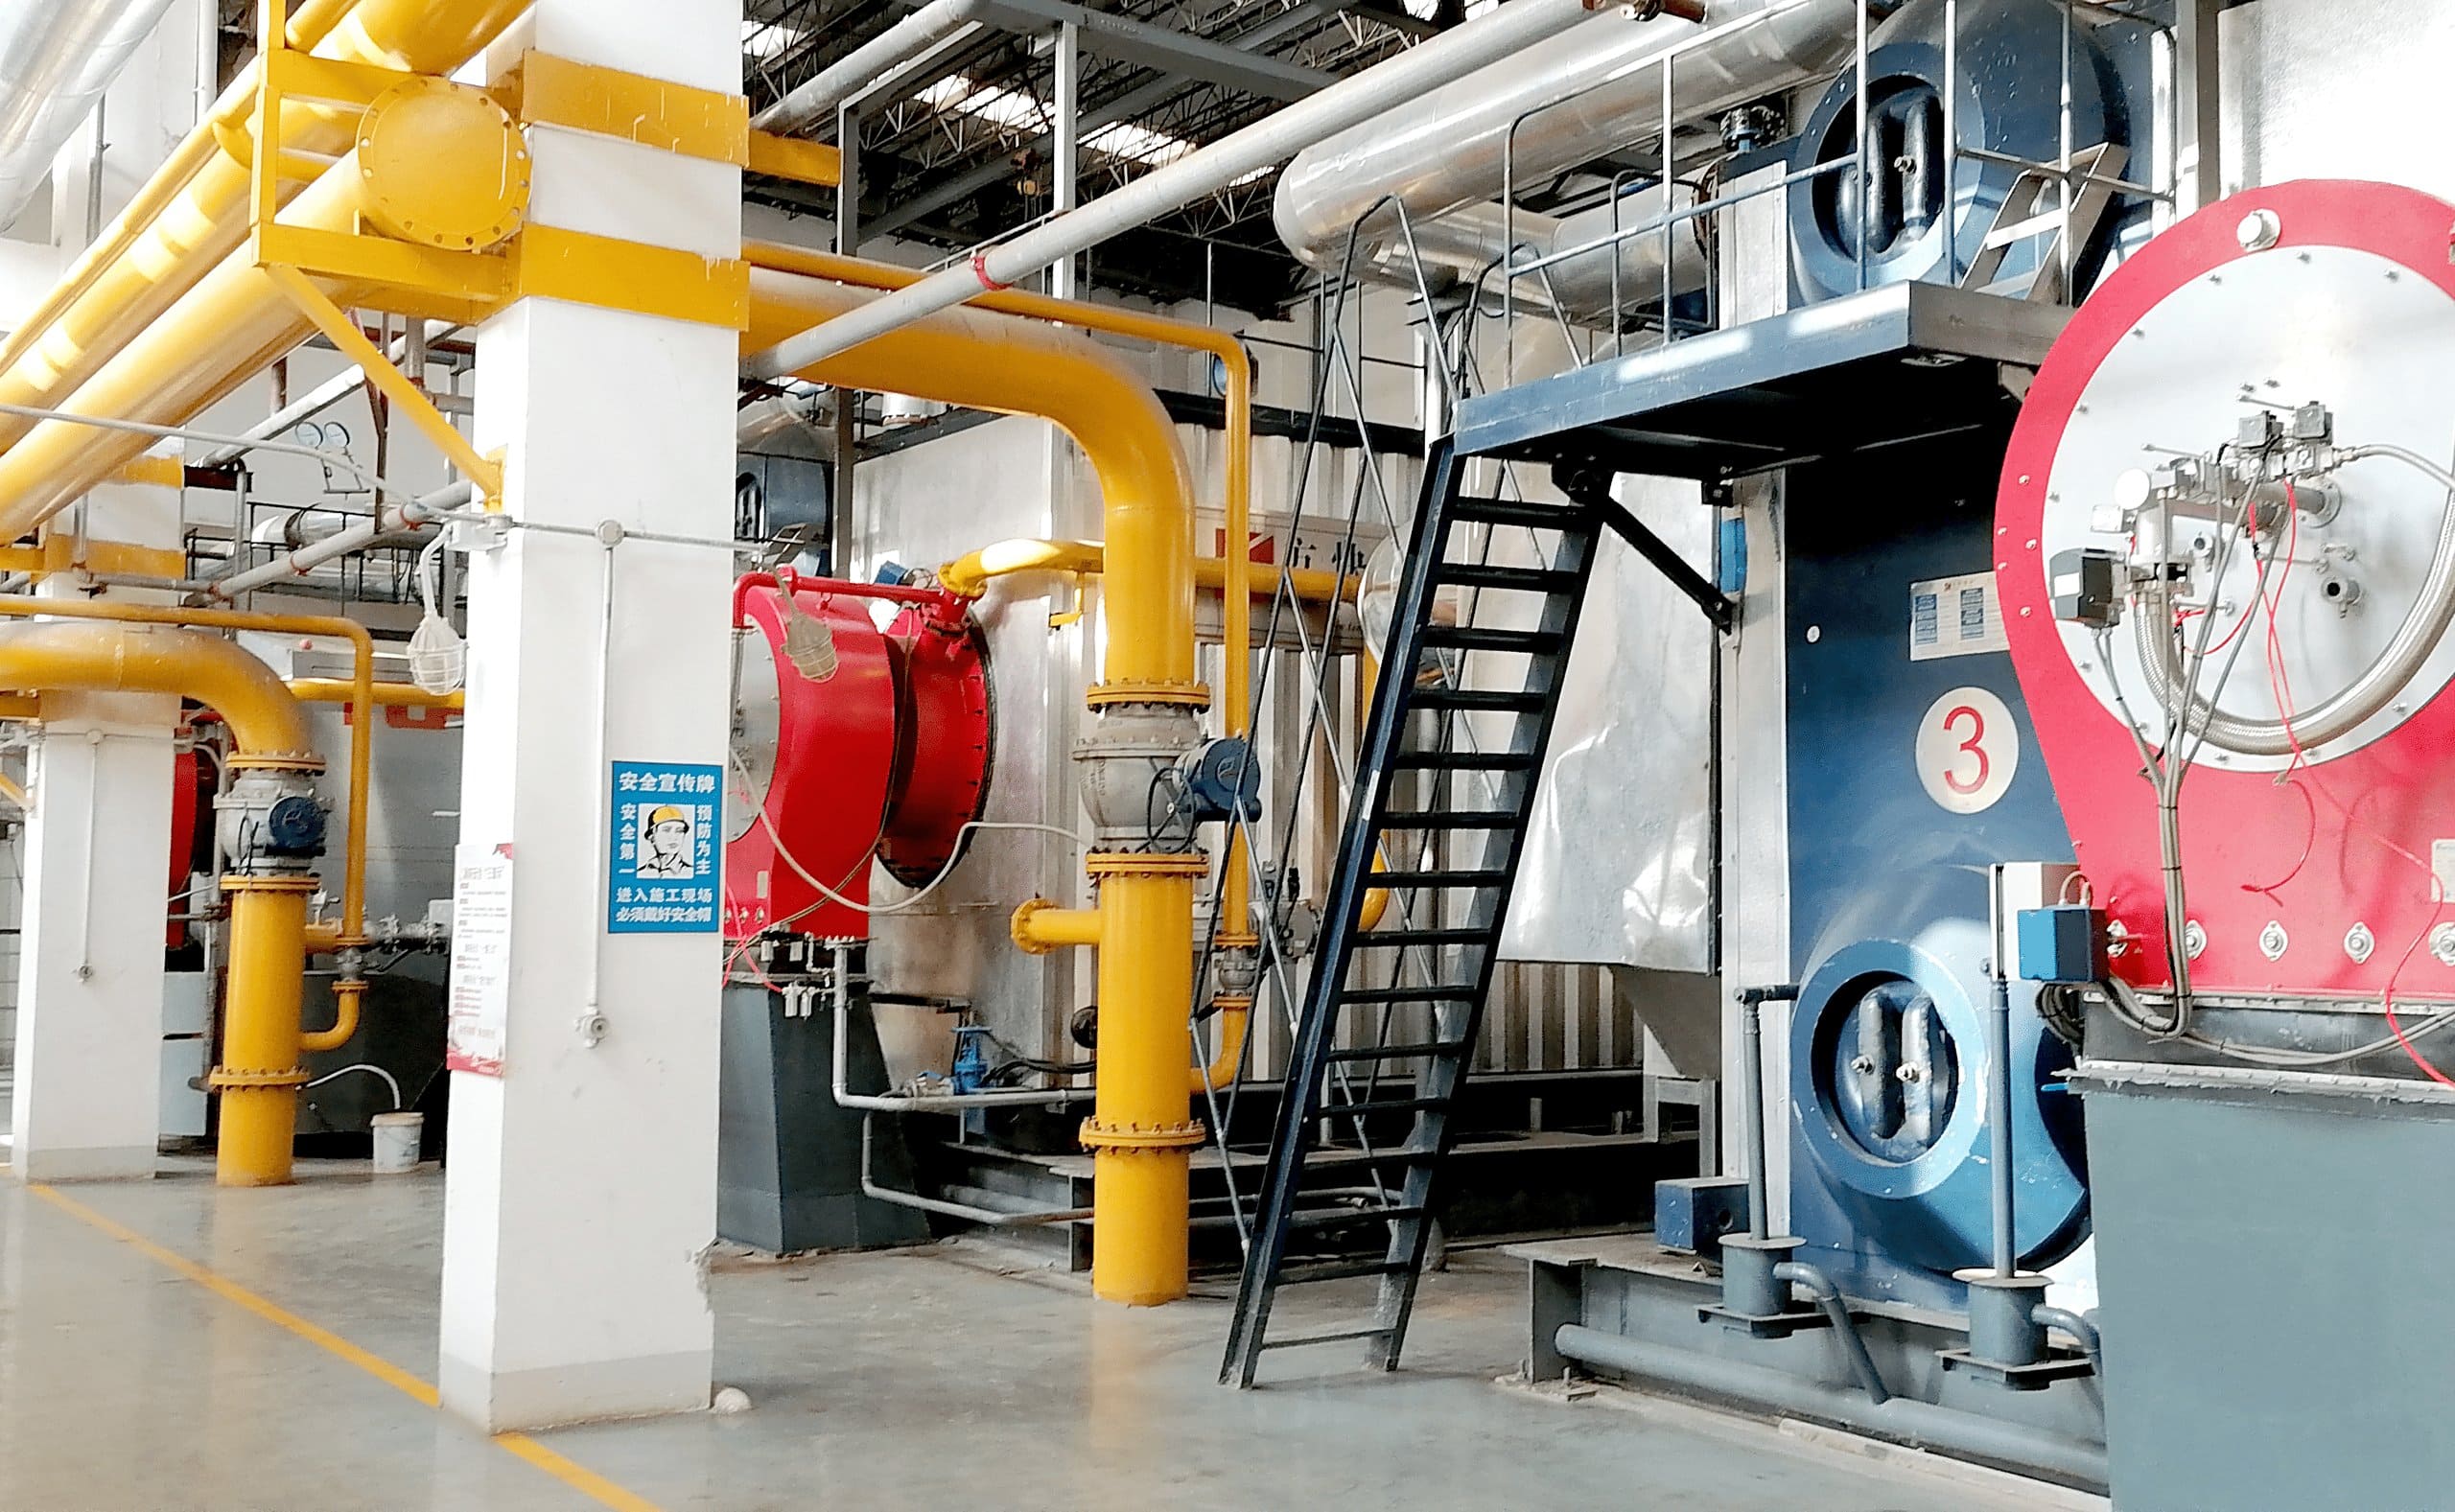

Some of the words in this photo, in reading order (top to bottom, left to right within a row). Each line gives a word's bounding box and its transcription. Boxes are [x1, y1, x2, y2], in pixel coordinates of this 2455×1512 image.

[1944, 706, 1989, 795] 3
[620, 771, 715, 793] 安全宣传牌
[619, 803, 637, 873] 安全第一
[695, 804, 713, 874] 预防为主
[616, 887, 713, 903] 进入施工现场
[616, 906, 713, 922] 必须戴好安全帽
